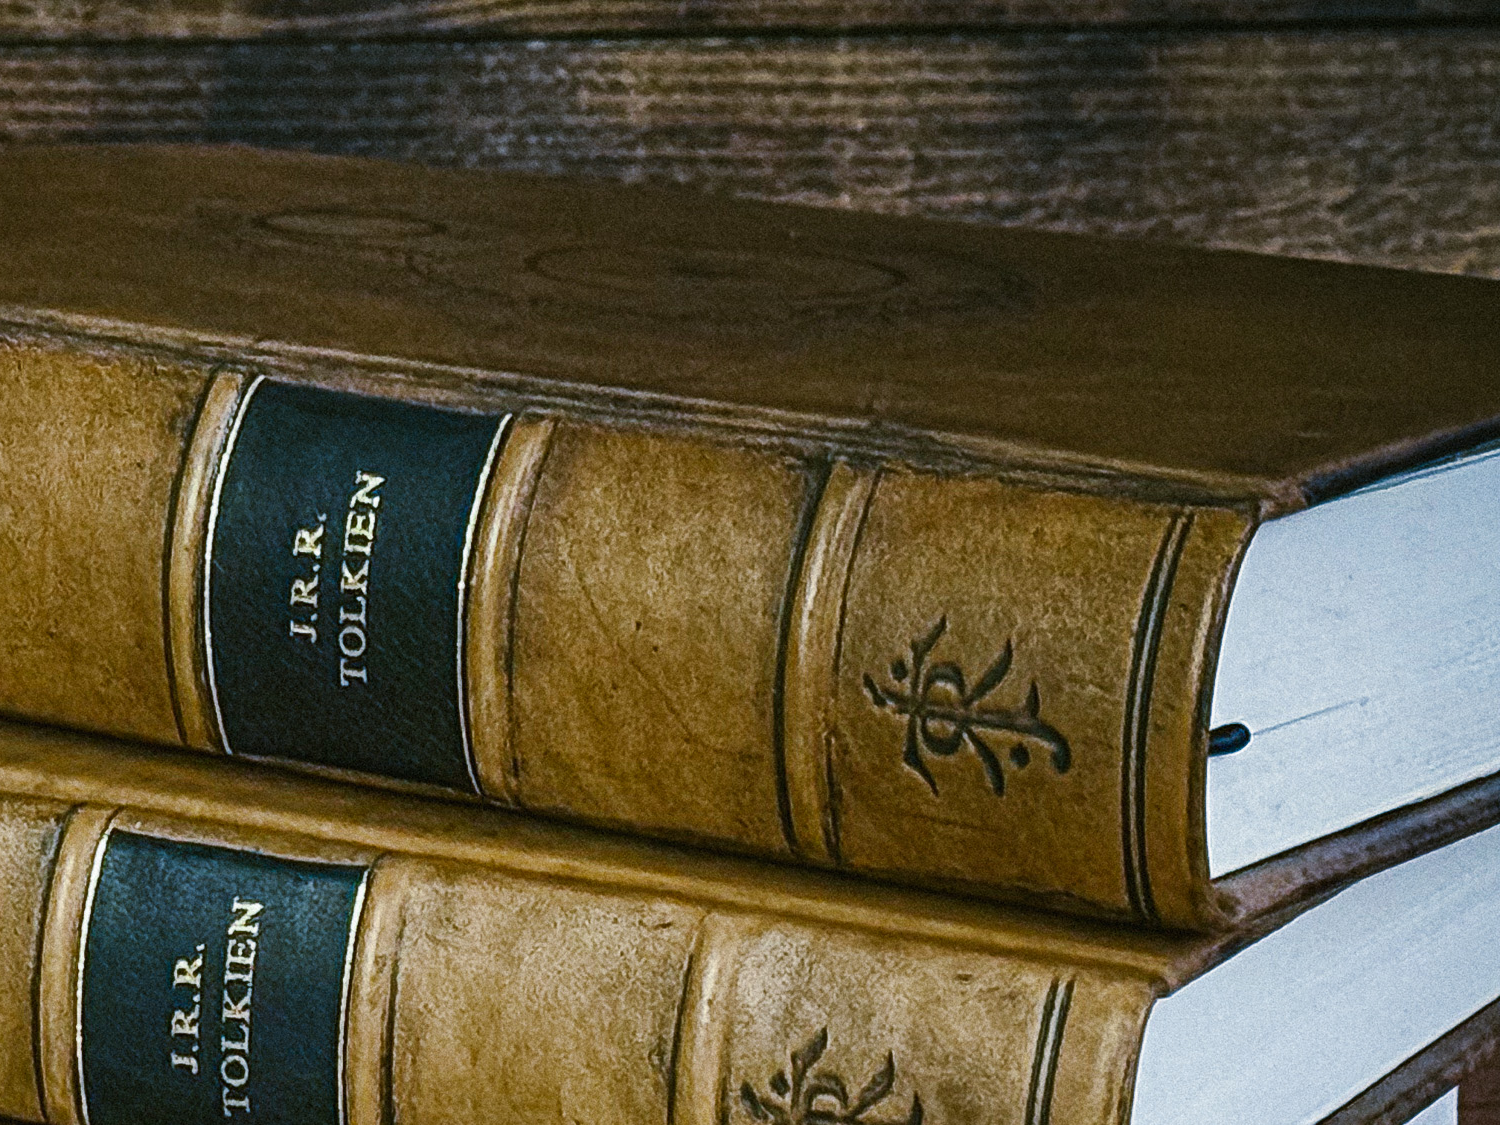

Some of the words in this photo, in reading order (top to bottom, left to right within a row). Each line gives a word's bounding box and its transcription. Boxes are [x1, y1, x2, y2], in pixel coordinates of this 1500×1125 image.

[289, 512, 327, 643] J.R.R.
[338, 469, 388, 687] TOLKIEN
[171, 943, 205, 1075] J.R.R.
[220, 896, 265, 1117] TOLKIEN
